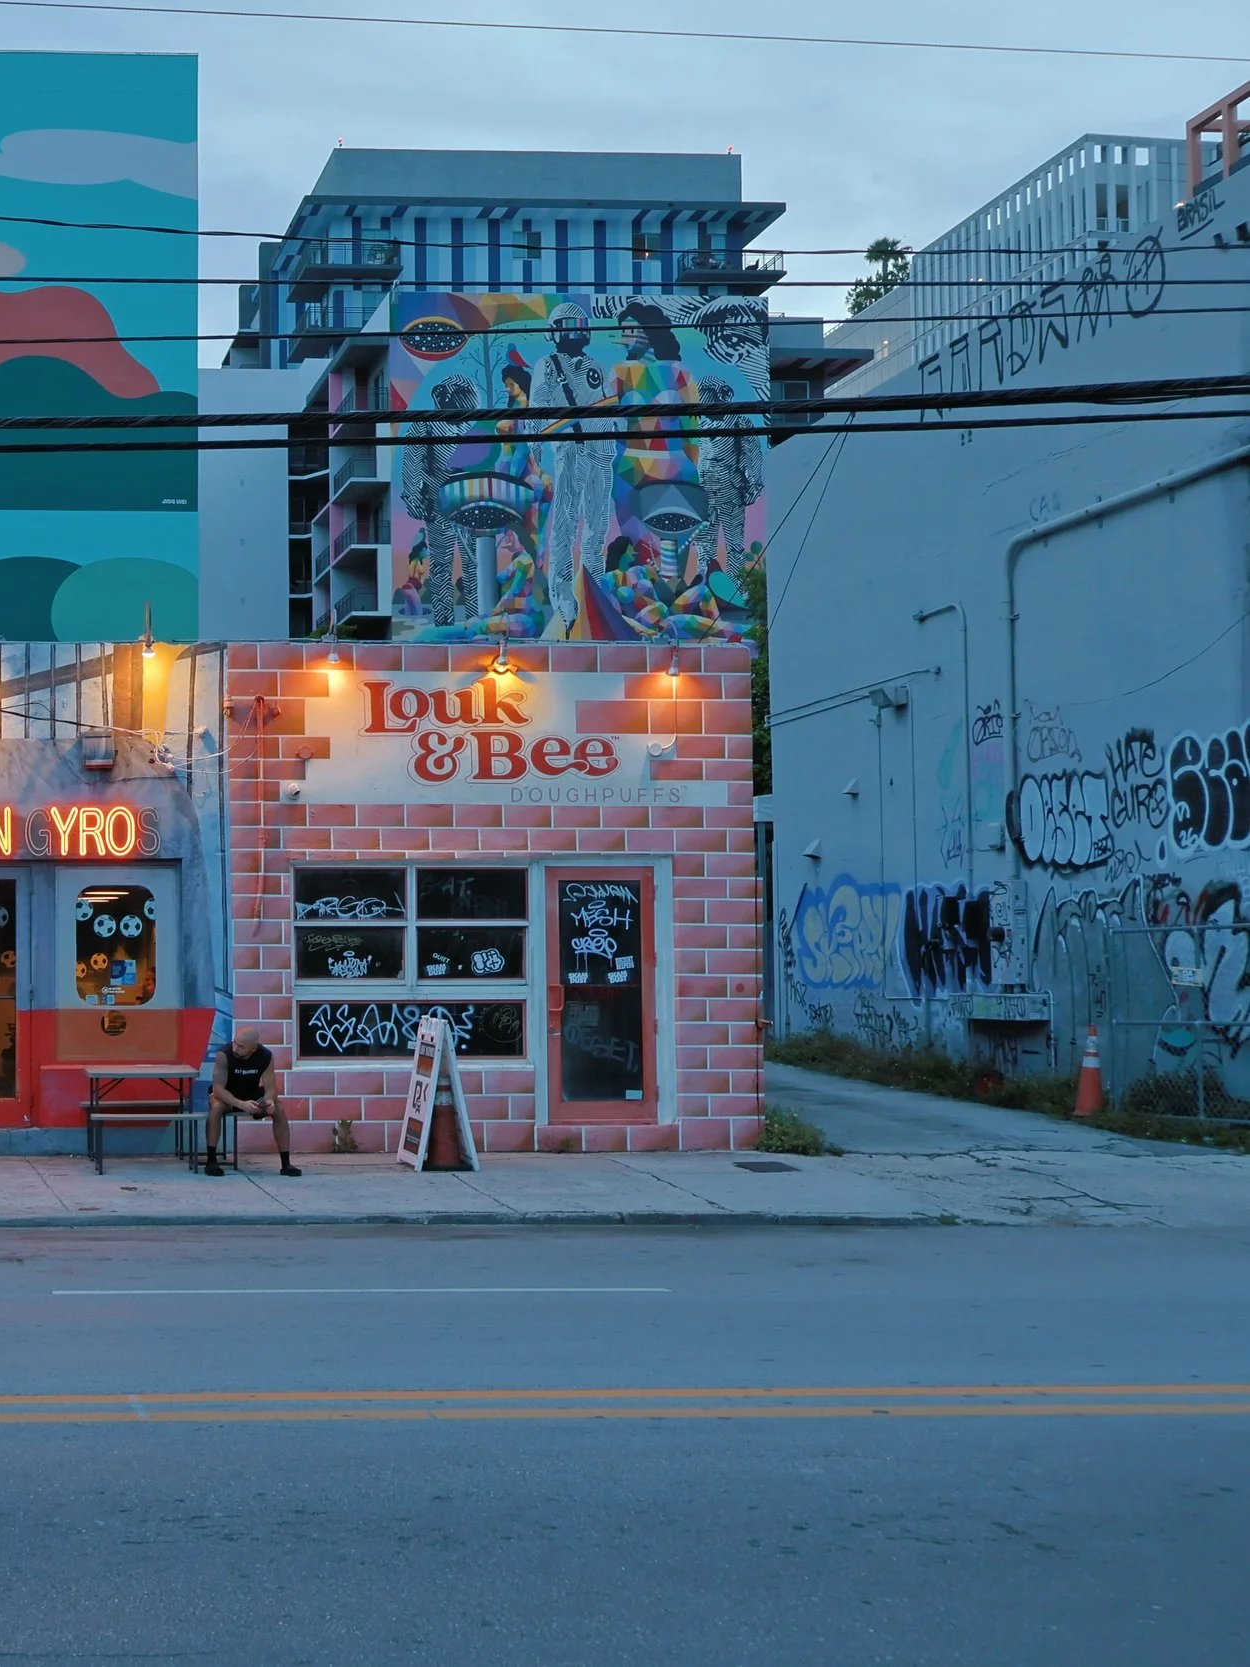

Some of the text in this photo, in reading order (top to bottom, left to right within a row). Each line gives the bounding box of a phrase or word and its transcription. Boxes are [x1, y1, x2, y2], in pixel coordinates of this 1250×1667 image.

[1177, 188, 1225, 233] BRASIL
[361, 677, 532, 735] Louk
[411, 730, 467, 783] &
[468, 730, 620, 782] Bee
[510, 786, 680, 803] DOUGHPUFFS
[25, 805, 161, 857] GYROS
